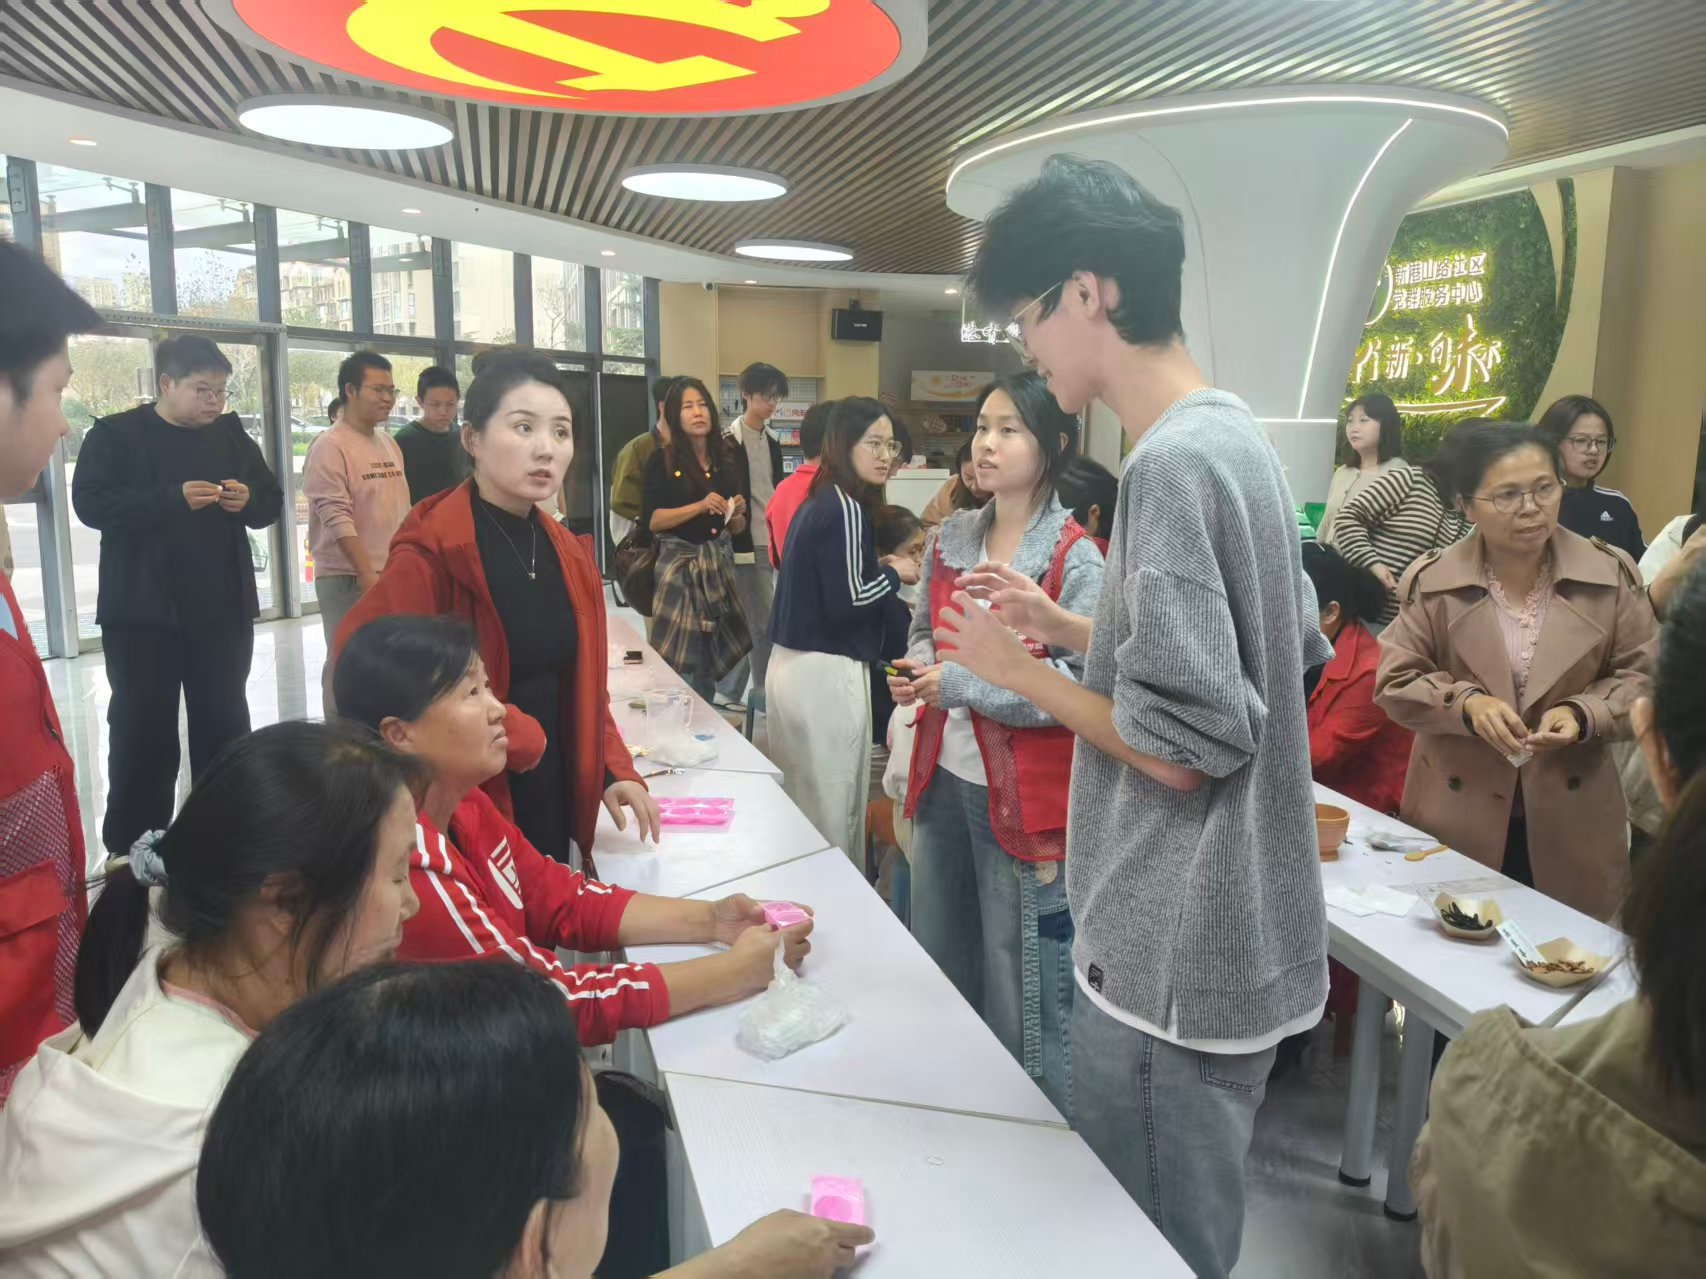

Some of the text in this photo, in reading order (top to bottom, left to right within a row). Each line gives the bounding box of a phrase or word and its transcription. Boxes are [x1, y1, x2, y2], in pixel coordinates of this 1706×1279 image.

[1395, 252, 1487, 285] 新港山路社区
[1393, 281, 1483, 310] 党群服务中心
